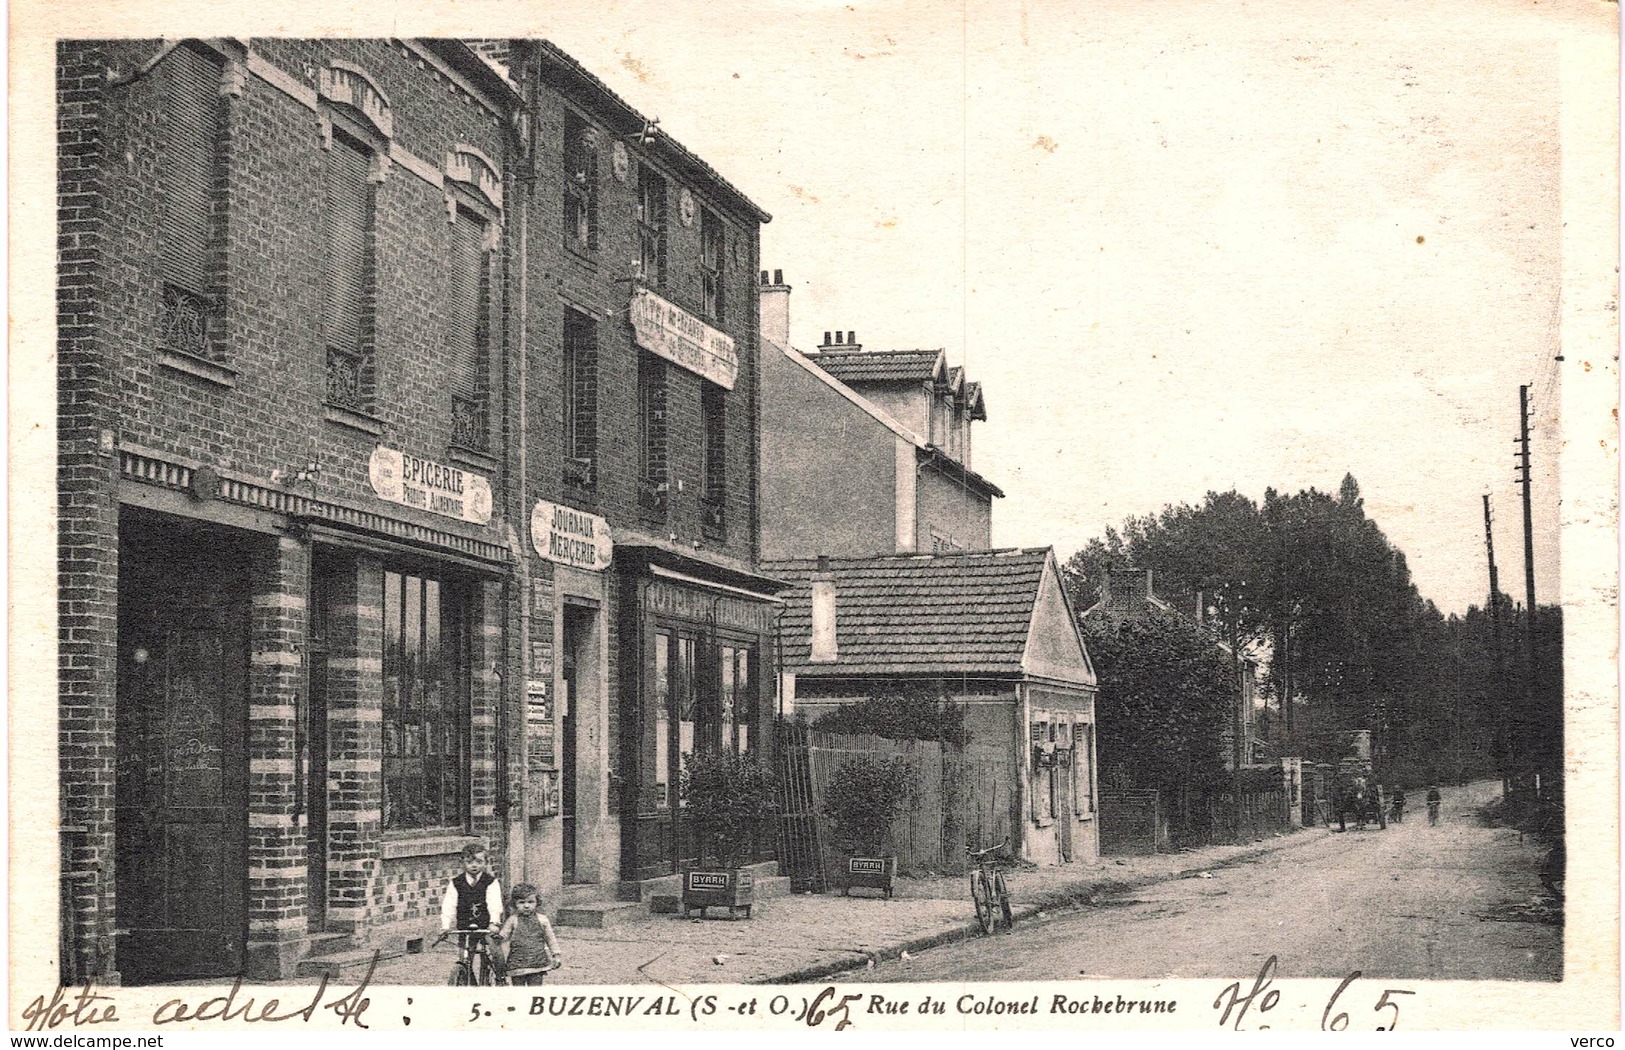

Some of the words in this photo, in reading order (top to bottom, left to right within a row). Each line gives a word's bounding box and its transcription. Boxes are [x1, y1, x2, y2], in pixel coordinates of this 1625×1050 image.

[401, 454, 464, 495] EPICERIE
[551, 505, 594, 539] JOURNAUX
[548, 531, 596, 565] MERCERIE
[693, 875, 725, 884] BYRRH
[852, 861, 881, 869] BYRRH
[1321, 971, 1416, 1031] 65
